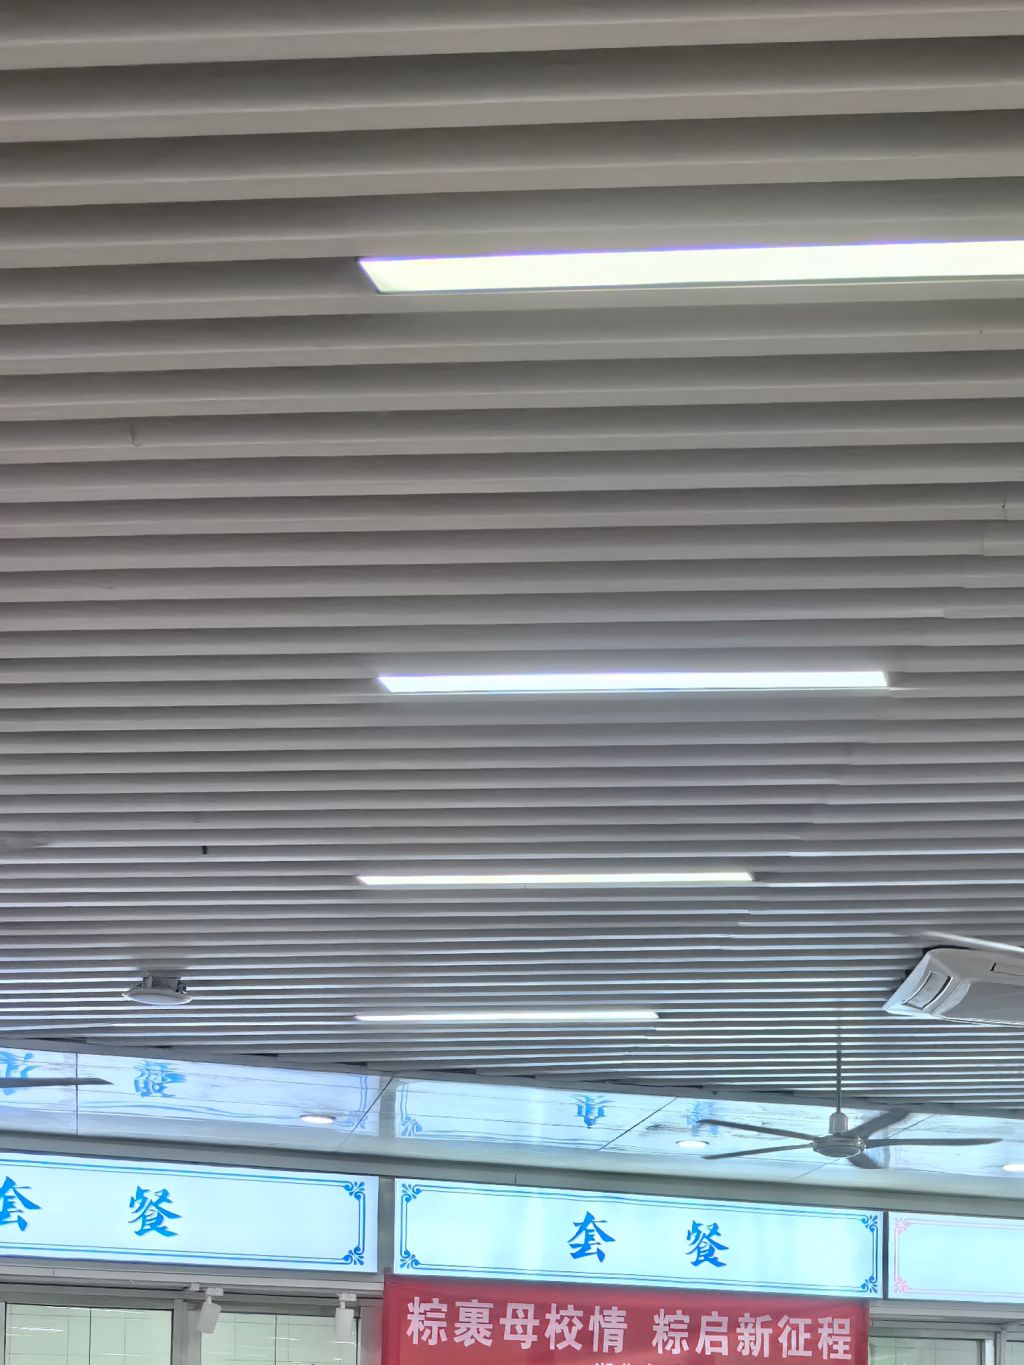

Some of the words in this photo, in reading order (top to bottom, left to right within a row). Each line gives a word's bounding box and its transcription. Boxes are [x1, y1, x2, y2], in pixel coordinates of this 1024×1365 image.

[0, 1176, 182, 1237] 套餐
[568, 1211, 729, 1267] 套餐
[406, 1296, 628, 1354] 粽裹母校情
[652, 1309, 852, 1360] 粽启新征程
